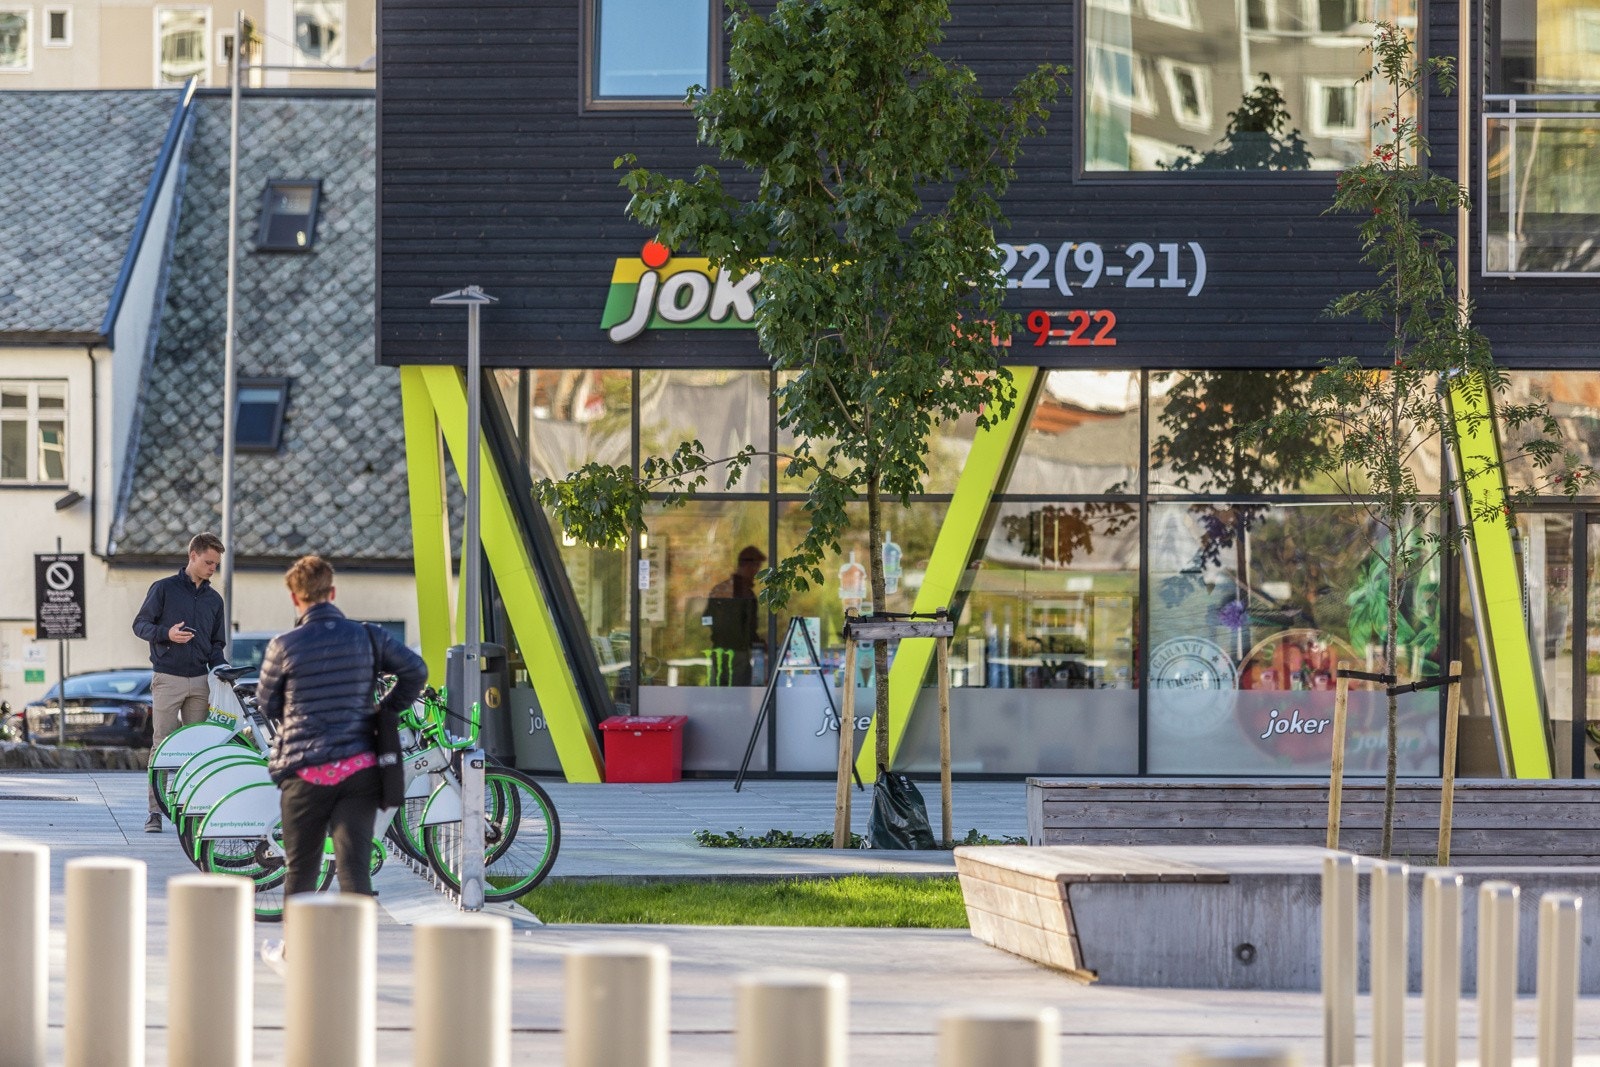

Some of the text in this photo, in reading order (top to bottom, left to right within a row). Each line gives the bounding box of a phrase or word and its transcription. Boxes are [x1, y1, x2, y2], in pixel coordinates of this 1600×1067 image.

[608, 240, 761, 343] jok
[1027, 309, 1116, 346] 9-22
[1260, 709, 1331, 739] joker
